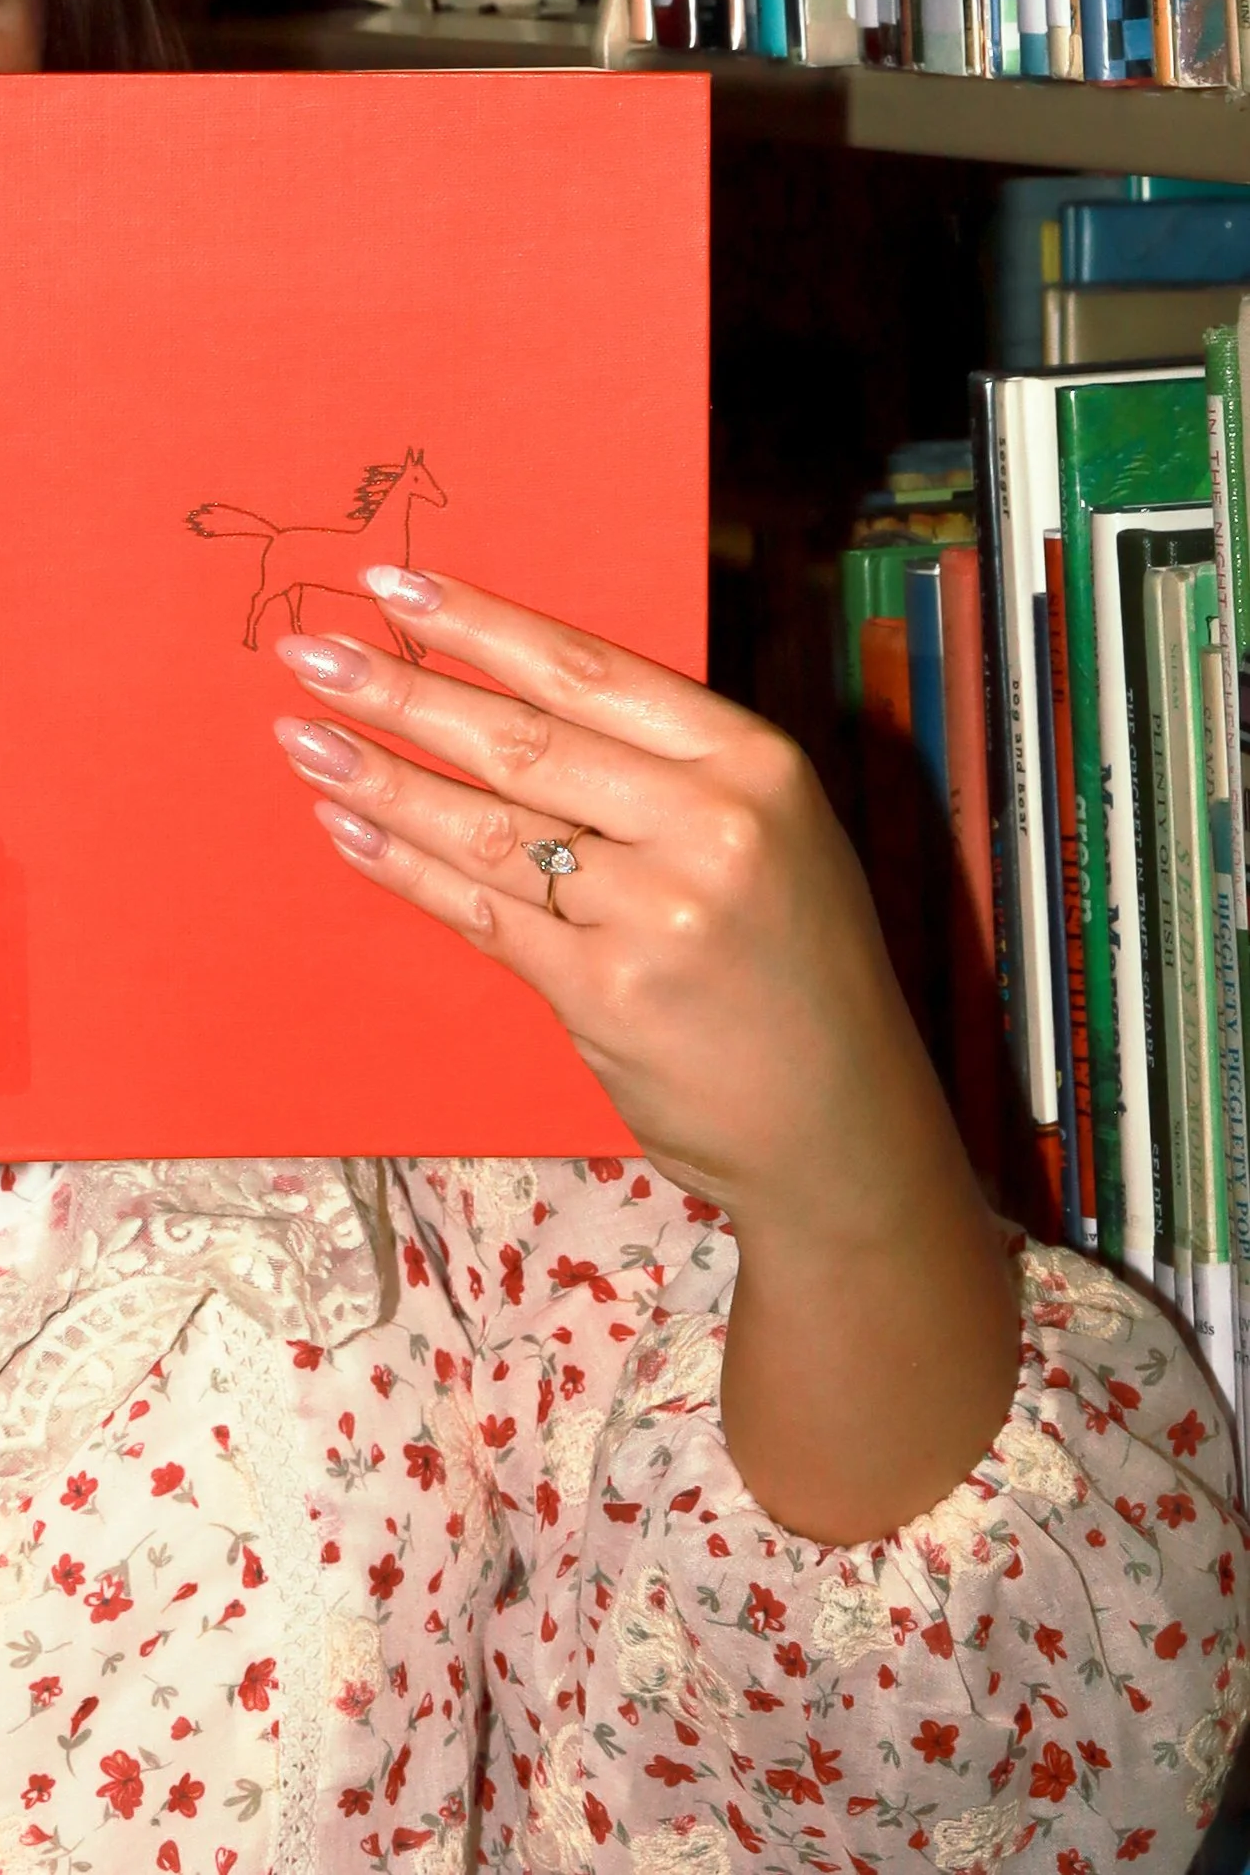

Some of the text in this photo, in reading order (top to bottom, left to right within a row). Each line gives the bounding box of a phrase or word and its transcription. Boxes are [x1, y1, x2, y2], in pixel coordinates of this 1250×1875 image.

[1208, 406, 1218, 436] IN
[1210, 450, 1222, 506] THE
[1214, 521, 1228, 609] NIGHT
[1219, 623, 1236, 749] KITCHEN
[1128, 743, 1143, 849] CRICKET
[1136, 856, 1144, 883] IN
[1152, 712, 1175, 968] PLENTY OF FISH
[1217, 892, 1239, 1036] HIGGLETY
[1226, 1048, 1249, 1189] PIGGLETY
